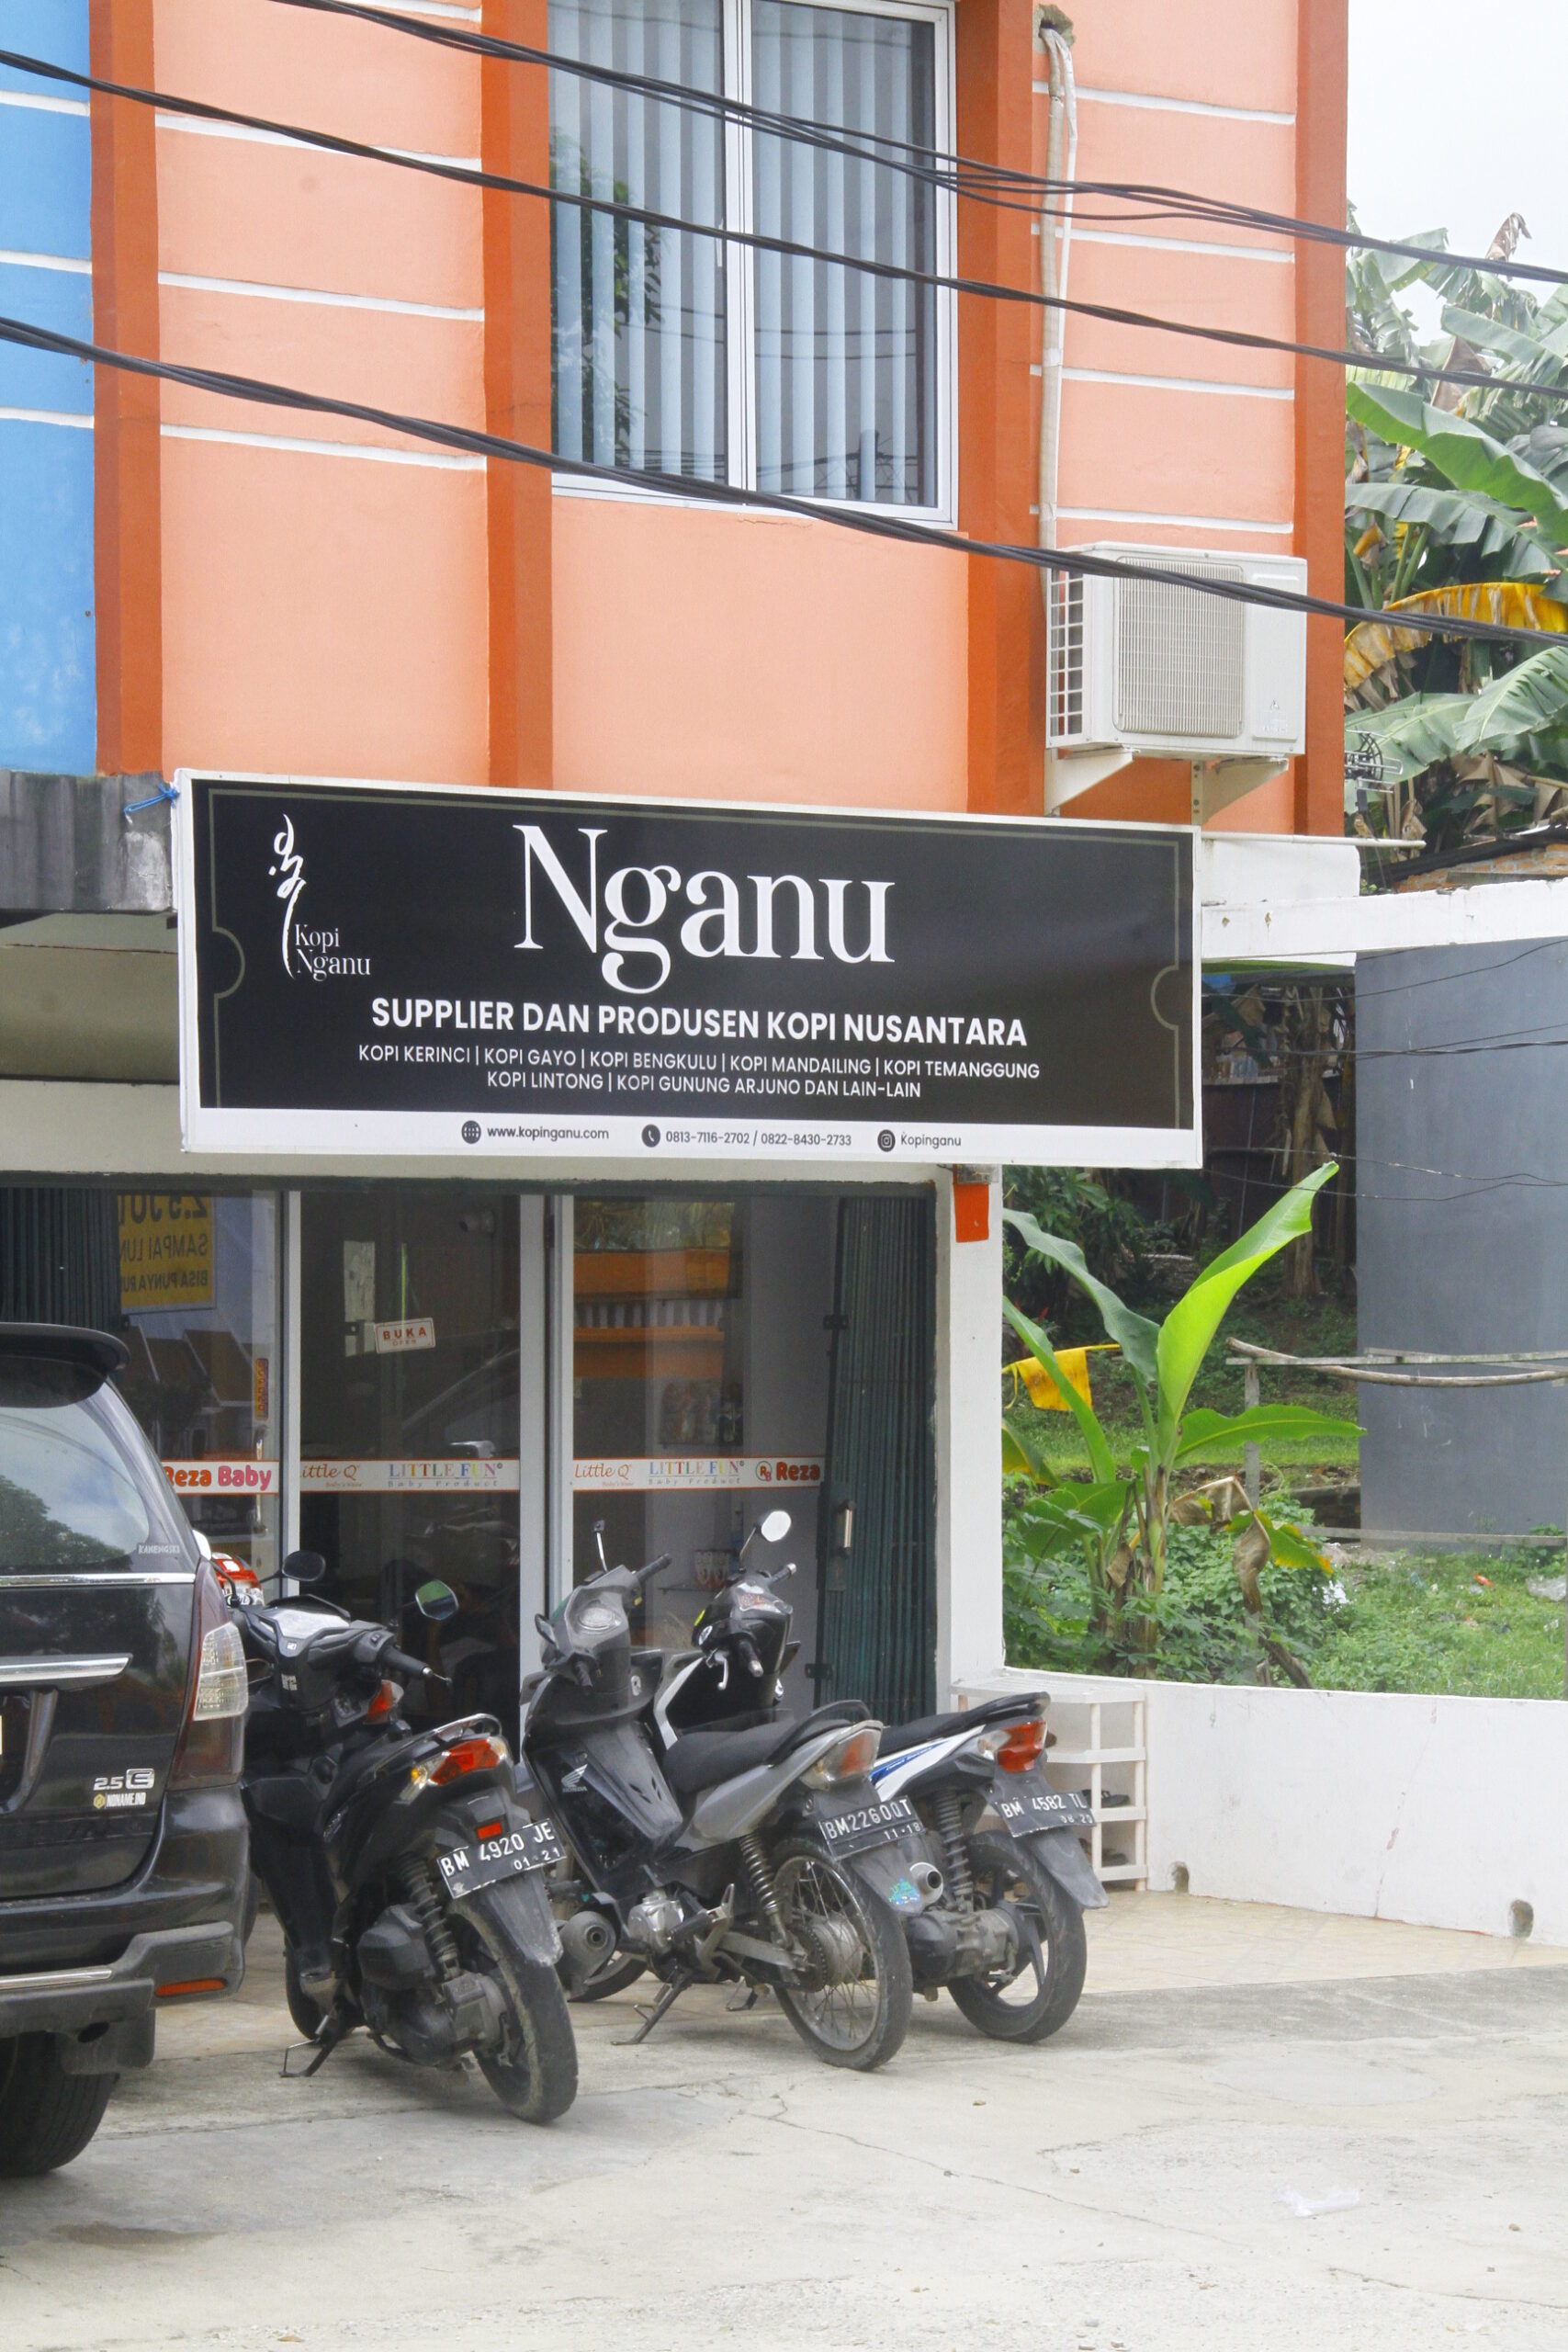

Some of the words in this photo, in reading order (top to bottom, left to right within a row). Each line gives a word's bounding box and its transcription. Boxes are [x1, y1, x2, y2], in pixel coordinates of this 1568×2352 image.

[512, 824, 896, 995] Nganu
[295, 923, 340, 954] Kopi
[297, 948, 371, 982] Nganu
[371, 997, 514, 1031] SUPPLIER
[523, 1001, 590, 1034] DAN
[598, 1004, 760, 1039] PRODUSEN
[767, 1011, 836, 1041] KOPI
[843, 1012, 1028, 1046] NUSANTARA
[358, 1044, 399, 1062] KOPI
[403, 1046, 471, 1063] KERINCI
[484, 1047, 524, 1065] KOPI
[527, 1048, 577, 1067] GAYO
[590, 1050, 628, 1069] KOPI
[633, 1052, 717, 1071] BENGKULU
[730, 1055, 768, 1072] KOPI
[772, 1056, 872, 1075] MANDAILING
[884, 1059, 920, 1076] KOPI
[924, 1060, 1040, 1080] TEMANGGUNG
[487, 1070, 526, 1088] KOPI
[531, 1071, 604, 1091] LINTONG
[616, 1074, 655, 1091] KOPI
[658, 1075, 730, 1093] GUNUNG
[734, 1077, 801, 1095] ARJUNO
[805, 1079, 839, 1096] DAN
[842, 1080, 921, 1098] LAIN-LAIN
[487, 1125, 609, 1142] www.kopinganu.com
[665, 1130, 750, 1144] 0813-7116-2702
[761, 1133, 852, 1146] 0822-8430-2733
[900, 1134, 962, 1149] Kopinganu
[382, 1326, 427, 1340] BUKA
[164, 1465, 212, 1487] Reza
[218, 1464, 272, 1491] Baby
[300, 1463, 340, 1479] ittle
[389, 1463, 455, 1477] LITTLE
[461, 1463, 496, 1478] FUN
[574, 1463, 615, 1478] Little
[649, 1462, 705, 1475] LITTLE
[709, 1461, 739, 1476] FUN
[776, 1461, 820, 1482] Reza
[93, 1776, 124, 1791] 2.5
[1001, 1801, 1025, 1818] BM
[1032, 1794, 1066, 1811] 4582
[1068, 1792, 1088, 1809] TL
[441, 1849, 470, 1877] BM
[479, 1833, 525, 1861] 4920
[533, 1821, 556, 1844] JE
